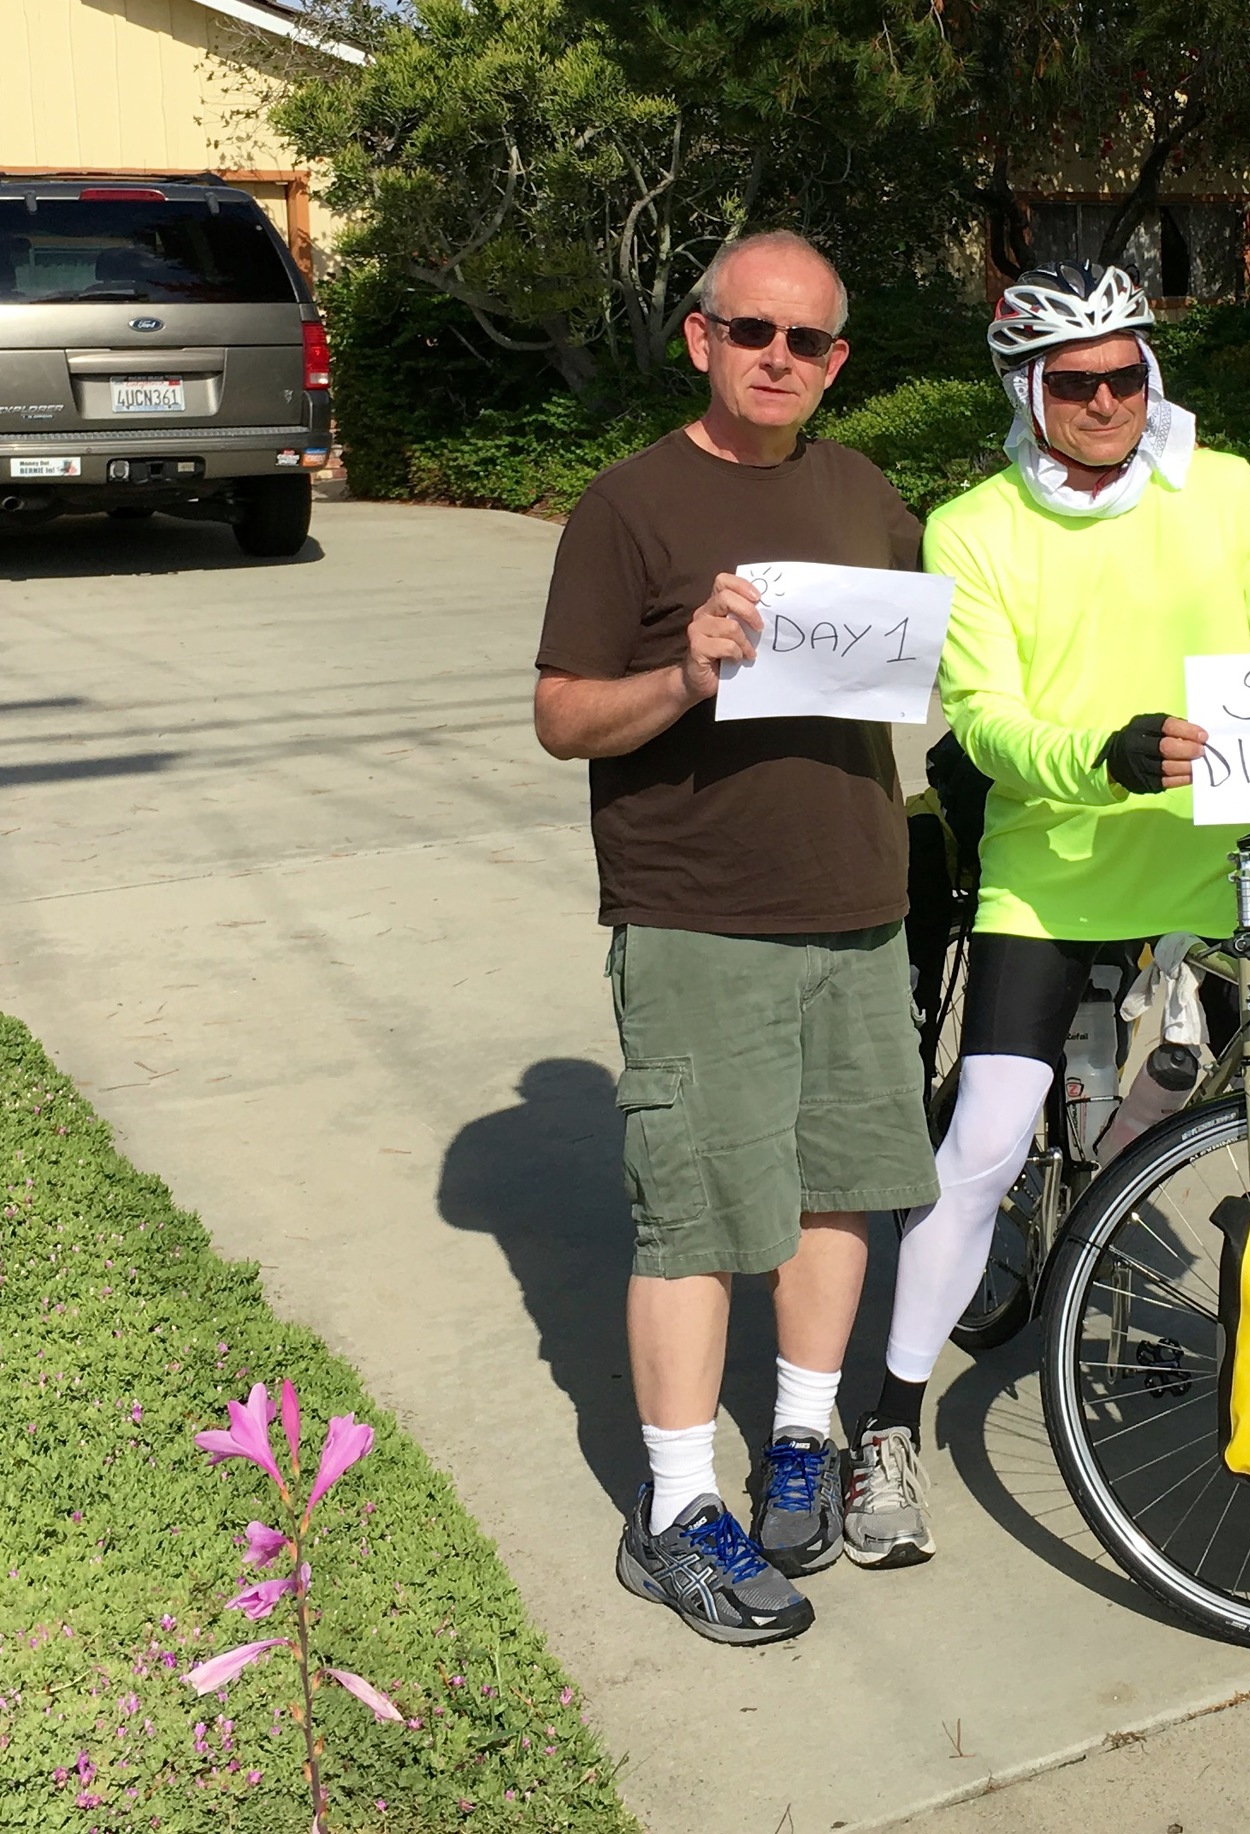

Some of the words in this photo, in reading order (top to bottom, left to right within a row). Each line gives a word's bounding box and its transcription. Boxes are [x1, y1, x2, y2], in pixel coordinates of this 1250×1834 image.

[137, 320, 156, 329] Ford
[117, 389, 179, 406] 4UCN361
[772, 614, 872, 657] DAY
[884, 617, 916, 663] 1
